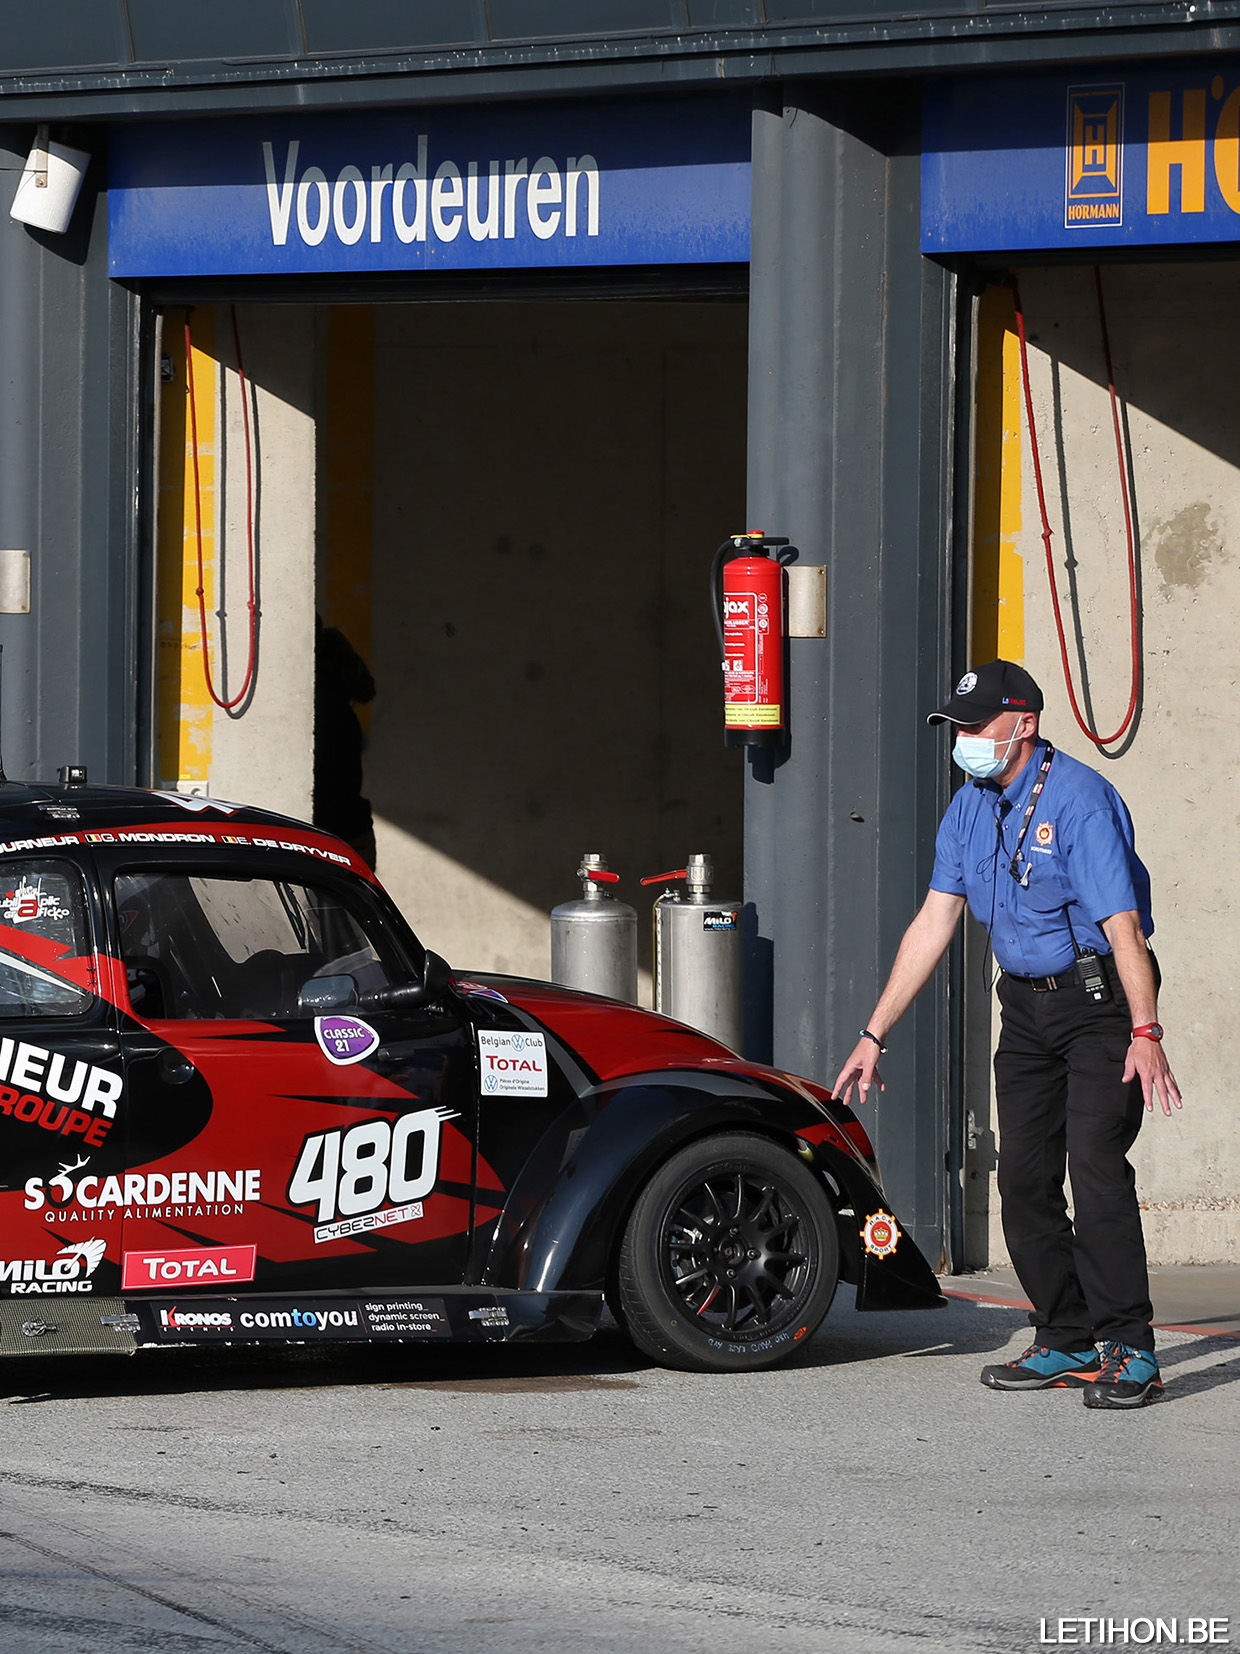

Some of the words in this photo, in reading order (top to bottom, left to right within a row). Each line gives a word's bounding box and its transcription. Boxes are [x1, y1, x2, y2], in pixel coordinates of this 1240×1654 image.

[262, 134, 601, 246] Voordeuren
[1068, 202, 1120, 220] HÖRMANN
[101, 834, 118, 843] G.
[119, 833, 216, 843] MONDRON
[238, 835, 252, 845] E.
[254, 838, 279, 848] DE
[278, 841, 352, 866] DRYVER
[323, 1028, 364, 1040] CLASSIC
[481, 1036, 511, 1048] Belgian
[525, 1038, 543, 1047] Club
[335, 1039, 351, 1053] 21
[485, 1055, 543, 1072] TOTAL
[289, 1106, 461, 1223] 480
[24, 1169, 261, 1211] SOCARDENNE
[45, 1209, 115, 1223] QUALITY
[123, 1203, 244, 1220] ALIMENTATION
[143, 1257, 237, 1280] TOTAL
[10, 1280, 93, 1294] RACING
[160, 1305, 233, 1326] KRONOS
[365, 1303, 385, 1311] sign
[240, 1308, 358, 1331] comtoyou
[368, 1312, 406, 1321] dynamic
[371, 1322, 395, 1331] radio
